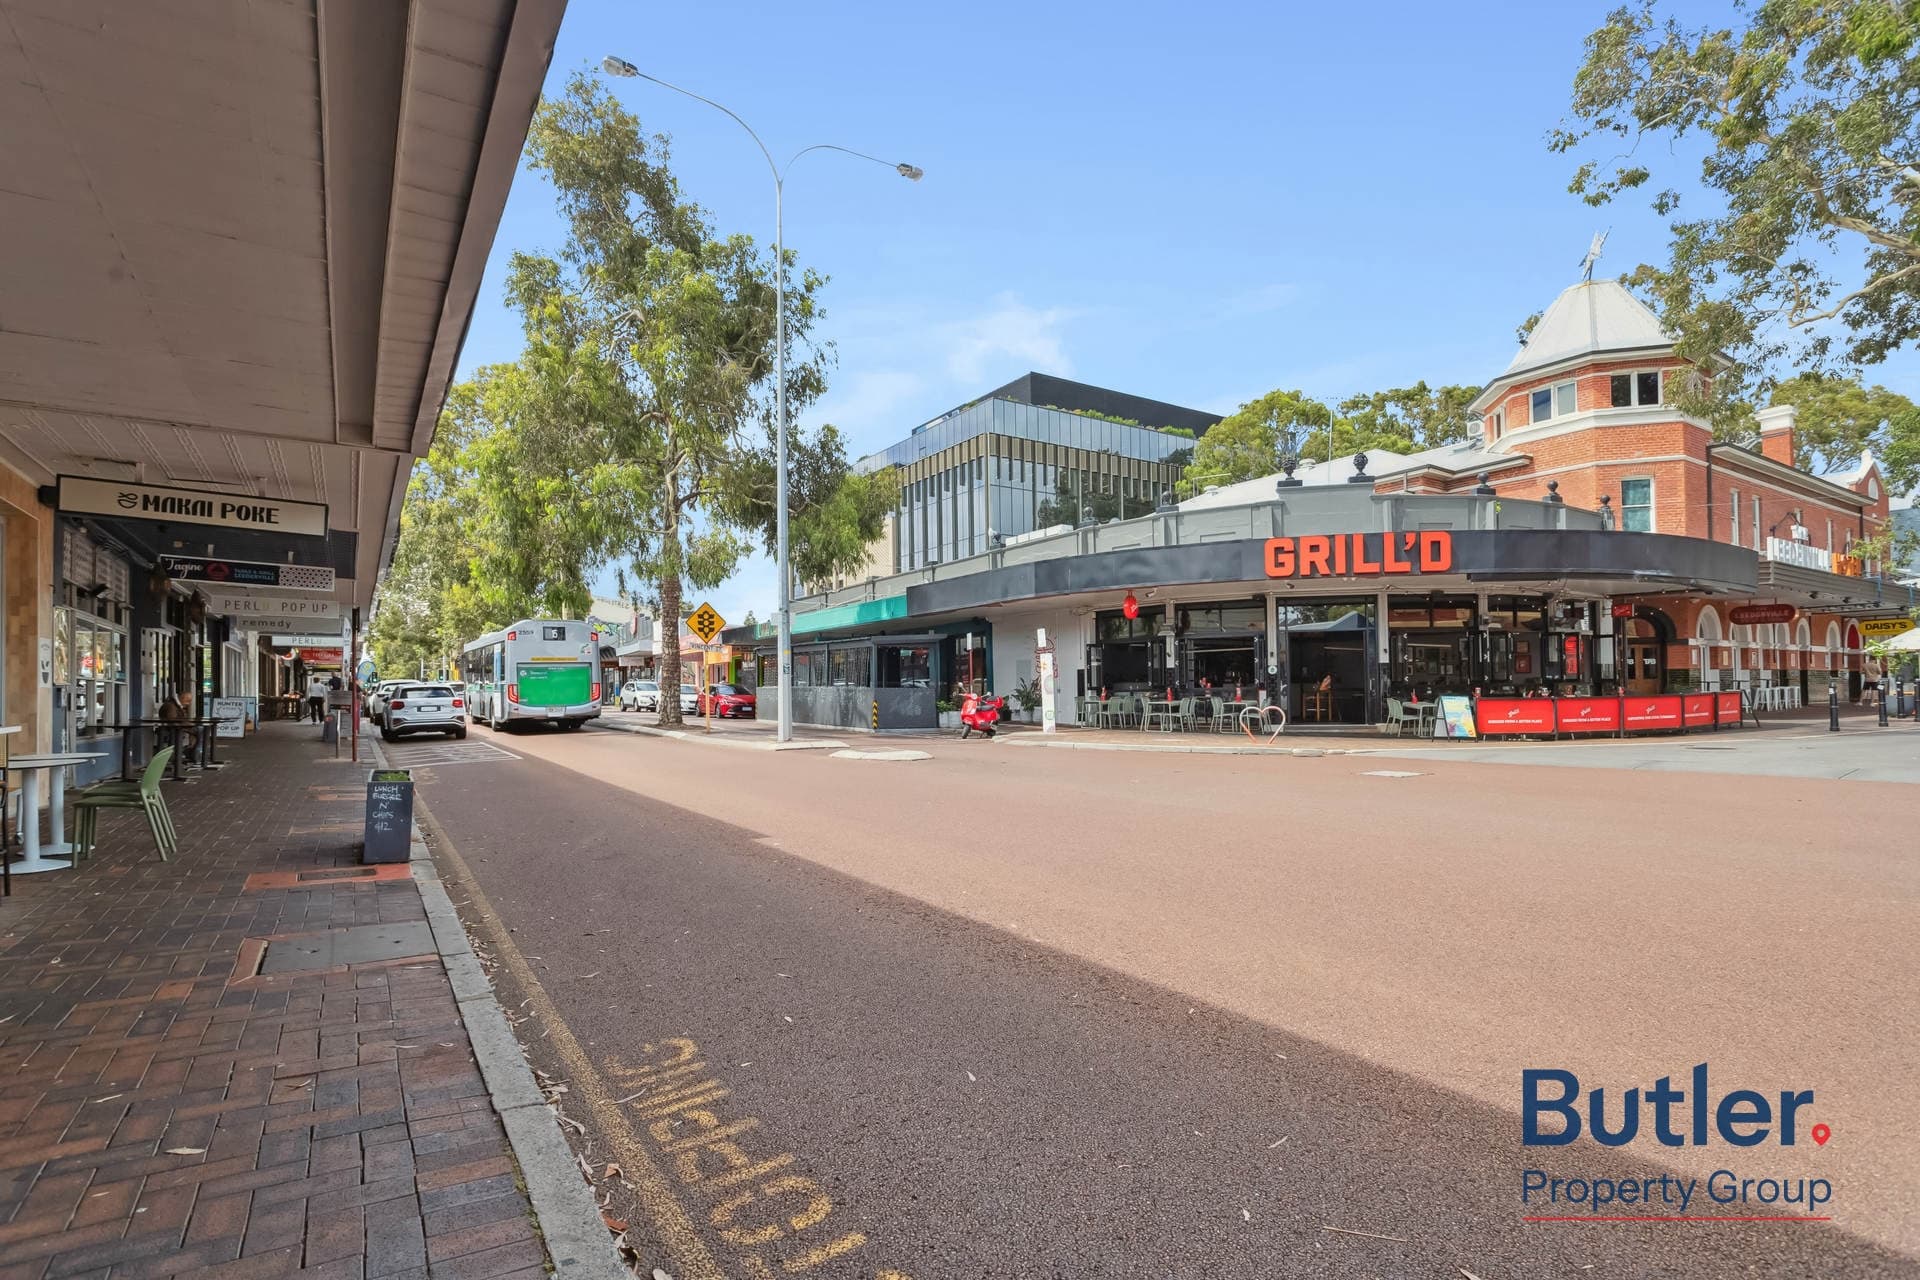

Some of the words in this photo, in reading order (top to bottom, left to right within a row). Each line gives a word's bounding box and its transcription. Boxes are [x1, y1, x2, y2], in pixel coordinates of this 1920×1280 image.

[142, 494, 213, 517] MAKAI
[220, 502, 279, 524] POKE
[1263, 530, 1452, 577] GRILL'D
[281, 602, 307, 613] POP
[312, 603, 328, 613] UP
[241, 620, 292, 629] remedy
[1864, 621, 1908, 630] DAISY'S
